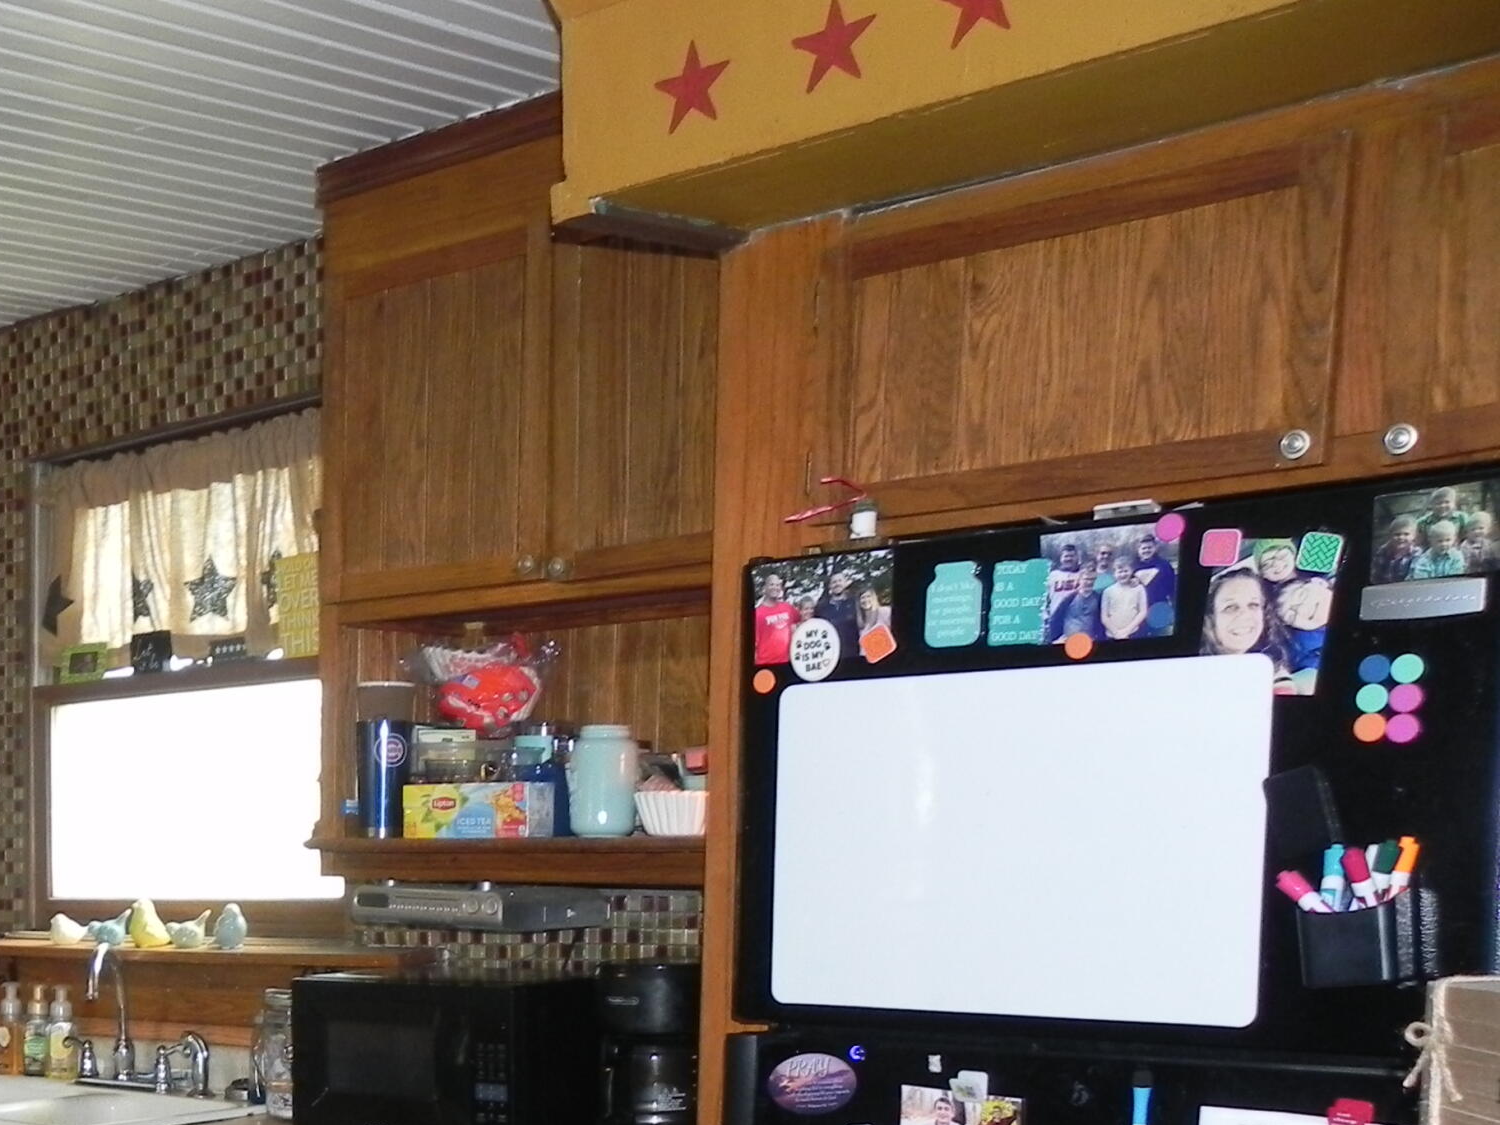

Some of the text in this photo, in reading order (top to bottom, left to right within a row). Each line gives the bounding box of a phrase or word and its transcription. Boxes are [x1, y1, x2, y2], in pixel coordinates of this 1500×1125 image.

[994, 599, 1019, 608] GOOD
[806, 630, 818, 639] MY
[991, 632, 1018, 641] GOOD
[804, 640, 822, 650] DOG
[802, 651, 825, 661] IS MY
[806, 663, 822, 673] BAE
[433, 799, 456, 809] Lipton
[457, 817, 476, 825] ICED
[786, 1057, 832, 1079] PRAY
